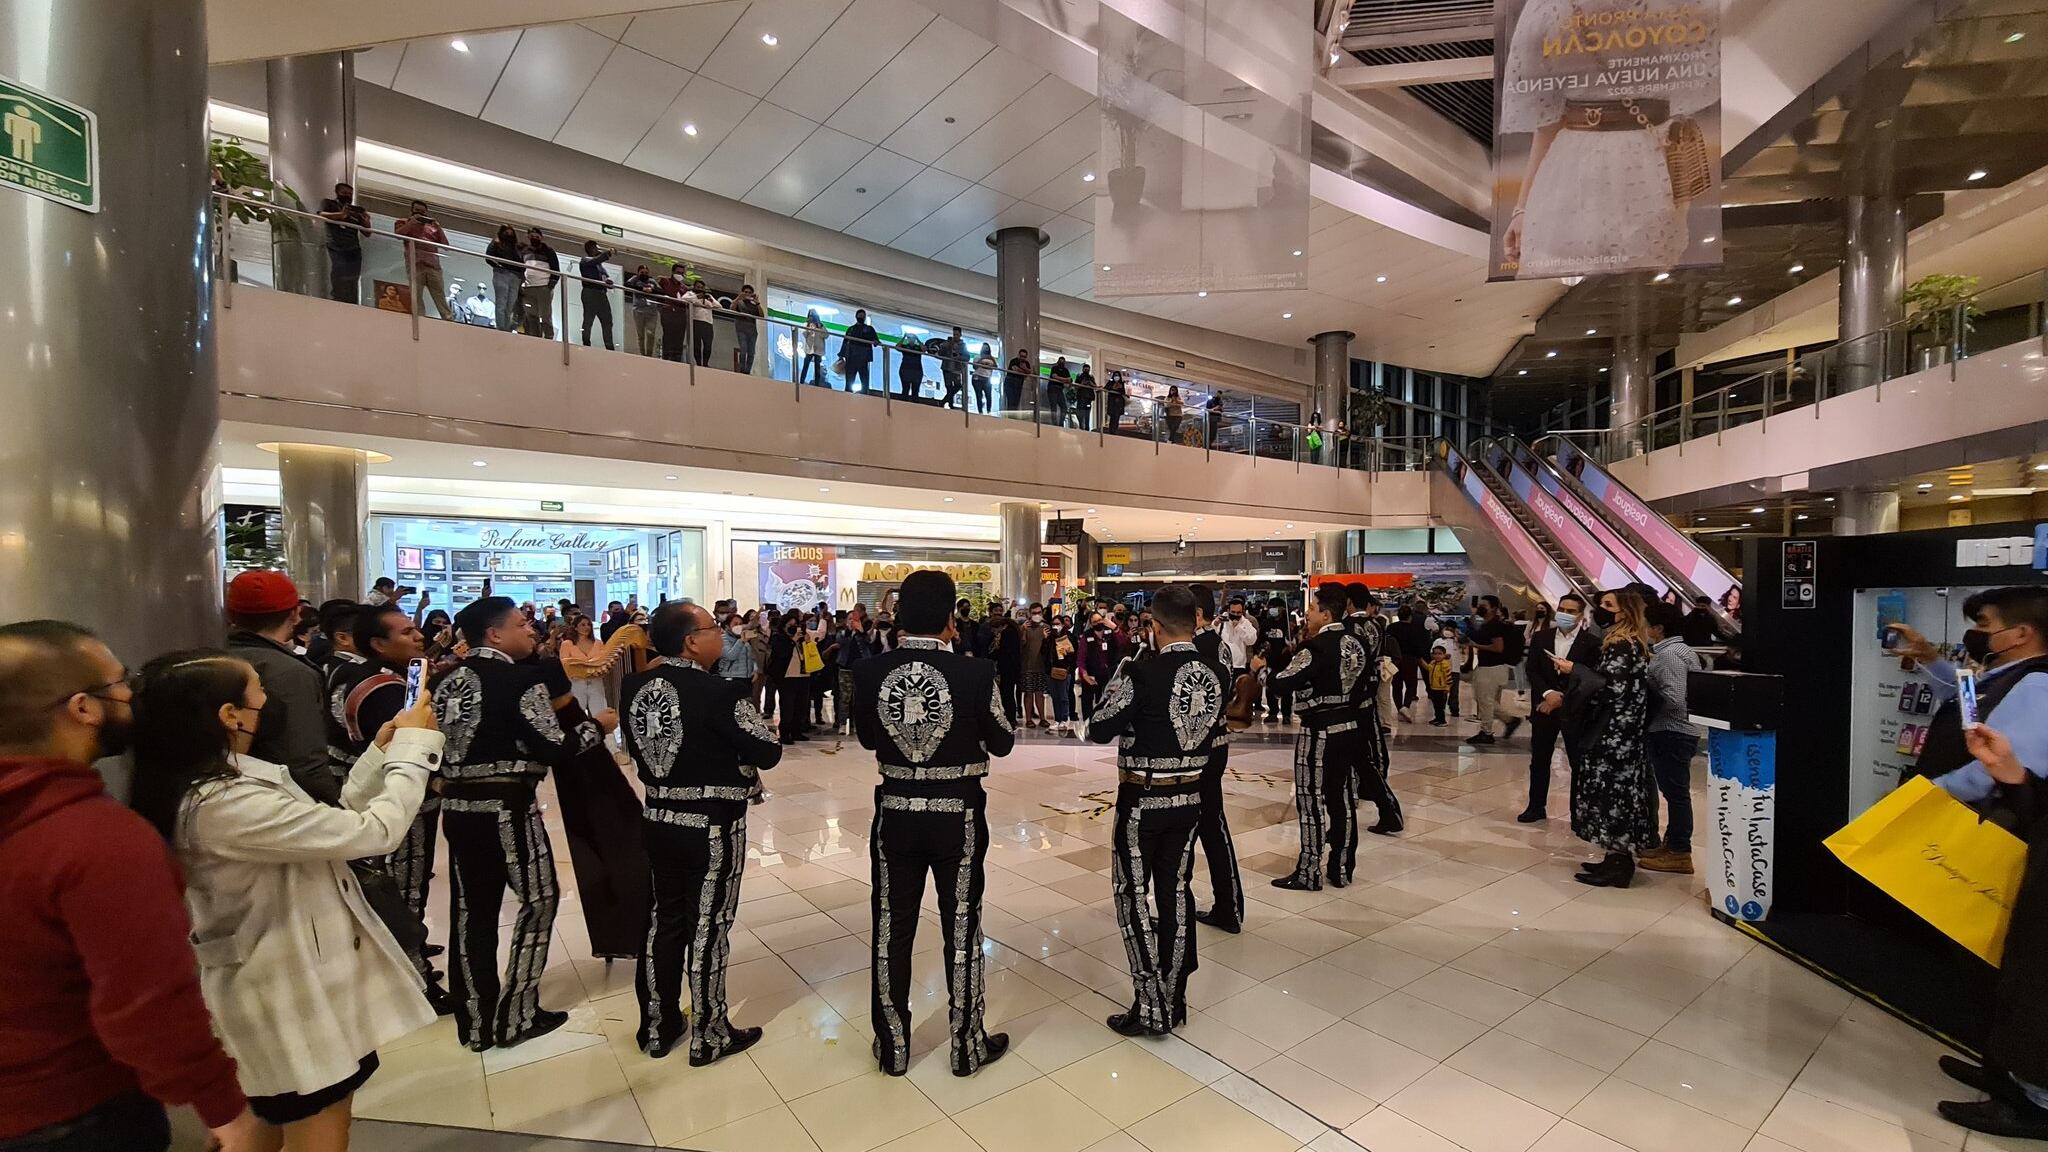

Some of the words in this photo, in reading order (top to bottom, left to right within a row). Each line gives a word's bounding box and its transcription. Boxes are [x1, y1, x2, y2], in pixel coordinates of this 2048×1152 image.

[37, 171, 57, 184] DE
[25, 177, 81, 202] RIESGO
[480, 528, 546, 550] Perfume
[550, 532, 608, 552] Gallery
[773, 546, 824, 560] HELADOS
[862, 562, 992, 582] McDald's
[888, 677, 915, 722] GAMA
[1179, 673, 1199, 714] GAMA
[1920, 693, 1932, 703] 12
[1718, 784, 1732, 803] tu
[1751, 794, 1772, 813] tu
[1748, 817, 1771, 898] InstaCase
